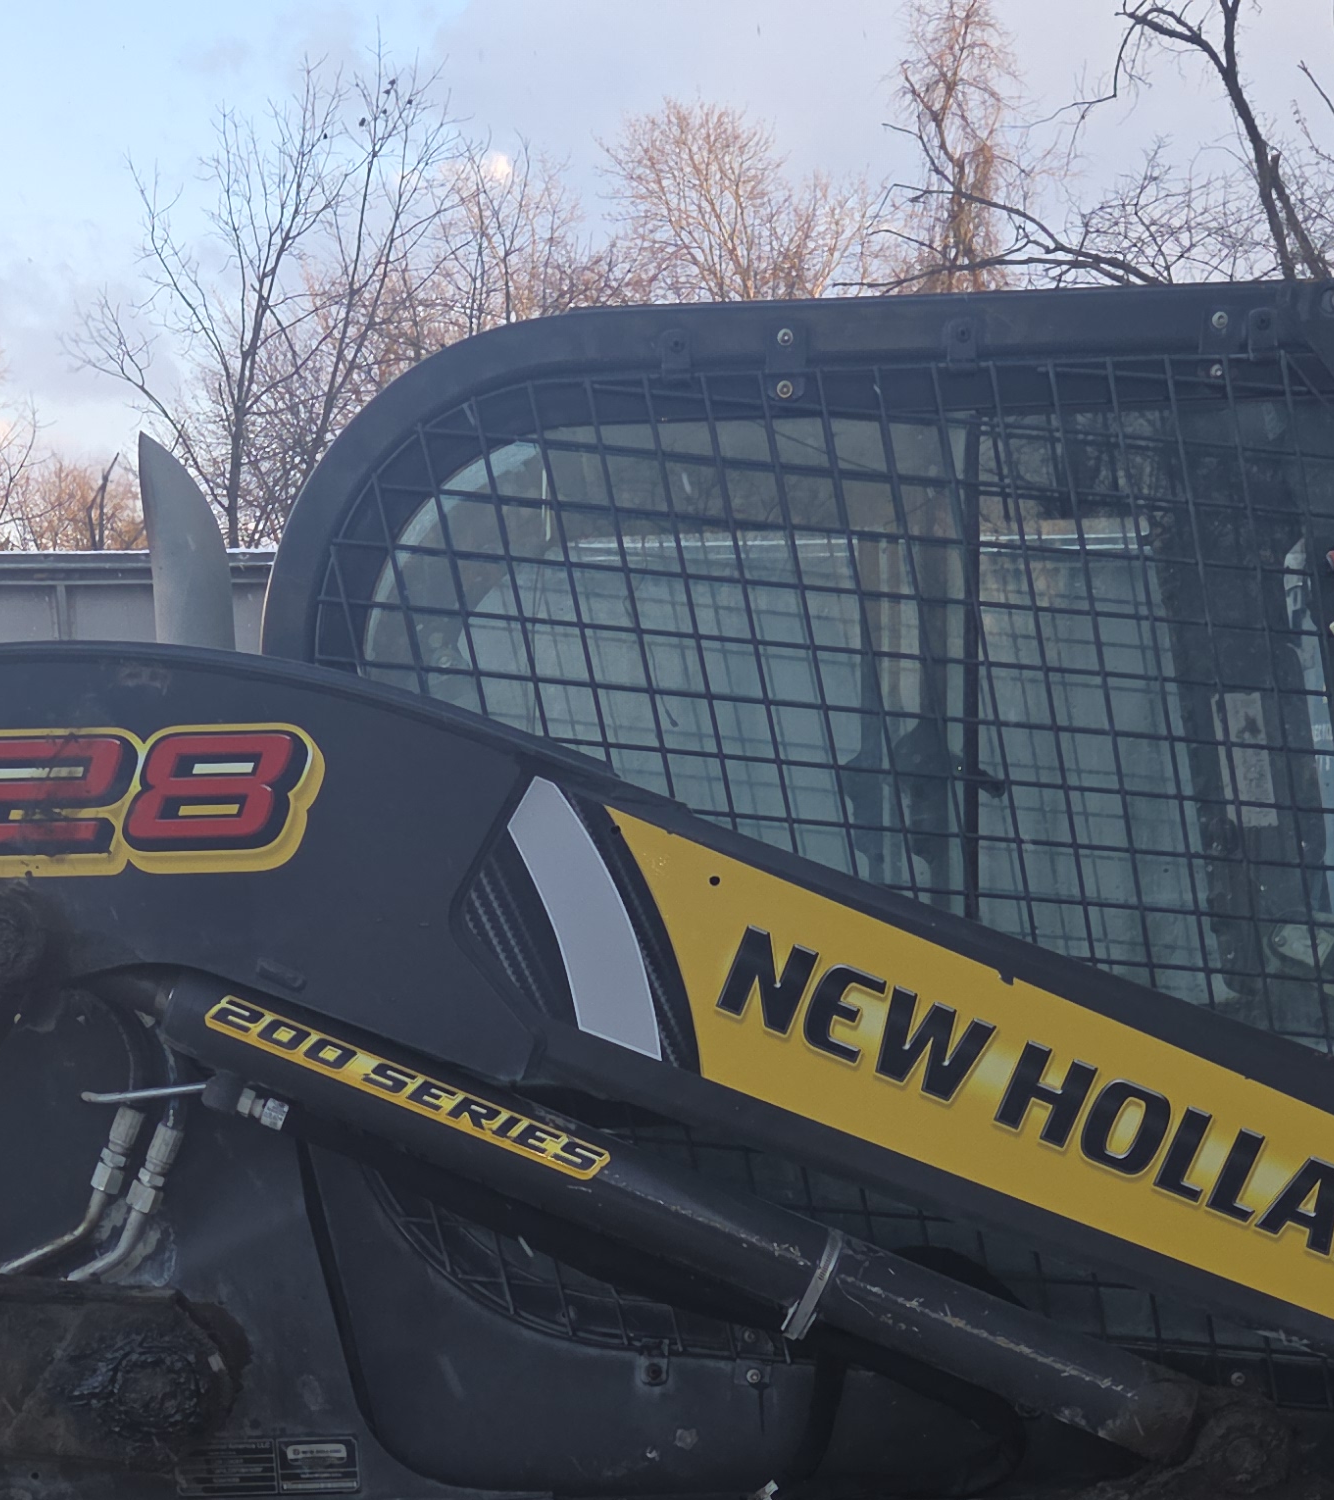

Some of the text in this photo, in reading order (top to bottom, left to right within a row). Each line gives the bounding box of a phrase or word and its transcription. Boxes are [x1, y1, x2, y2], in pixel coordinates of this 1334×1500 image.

[208, 999, 608, 1172] 200 SERIES
[714, 923, 996, 1102] NEW
